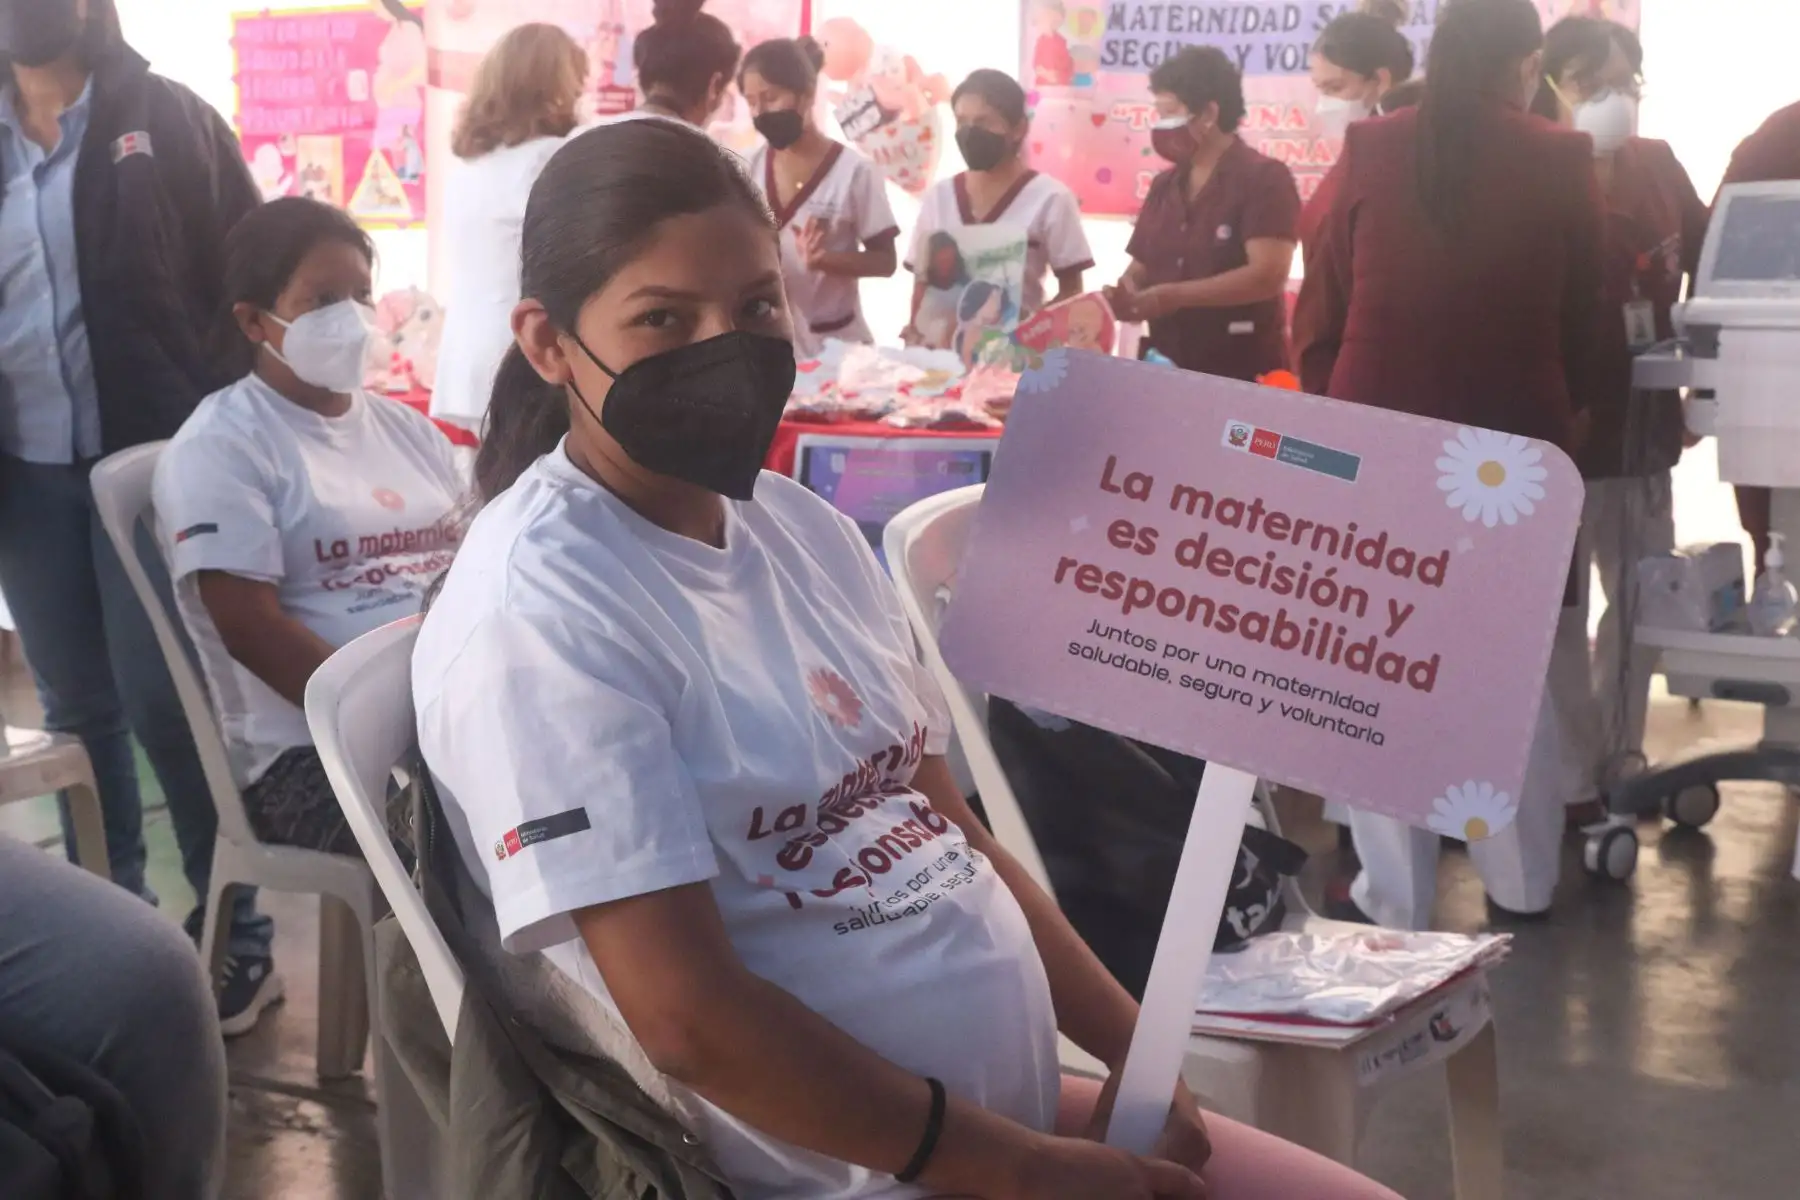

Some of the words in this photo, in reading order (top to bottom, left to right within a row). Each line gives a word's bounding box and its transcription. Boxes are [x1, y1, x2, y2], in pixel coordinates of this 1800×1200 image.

[1107, 3, 1301, 34] MATERNIDAD
[314, 538, 350, 562] La
[1100, 455, 1154, 502] La
[1170, 484, 1450, 588] maternidad
[1054, 556, 1441, 693] responsabilidad
[1107, 519, 1159, 555] es
[1175, 532, 1369, 618] decisión
[1384, 598, 1415, 638] y
[1067, 641, 1172, 684] saludable,
[1179, 673, 1253, 706] segura
[1257, 697, 1274, 714] y
[1280, 702, 1386, 746] voluntaria
[1086, 618, 1158, 652] Juntos
[1162, 643, 1200, 664] por
[1205, 655, 1247, 678] una
[1252, 669, 1380, 718] maternidad
[747, 803, 807, 841] La
[906, 867, 932, 892] por
[932, 850, 960, 872] una
